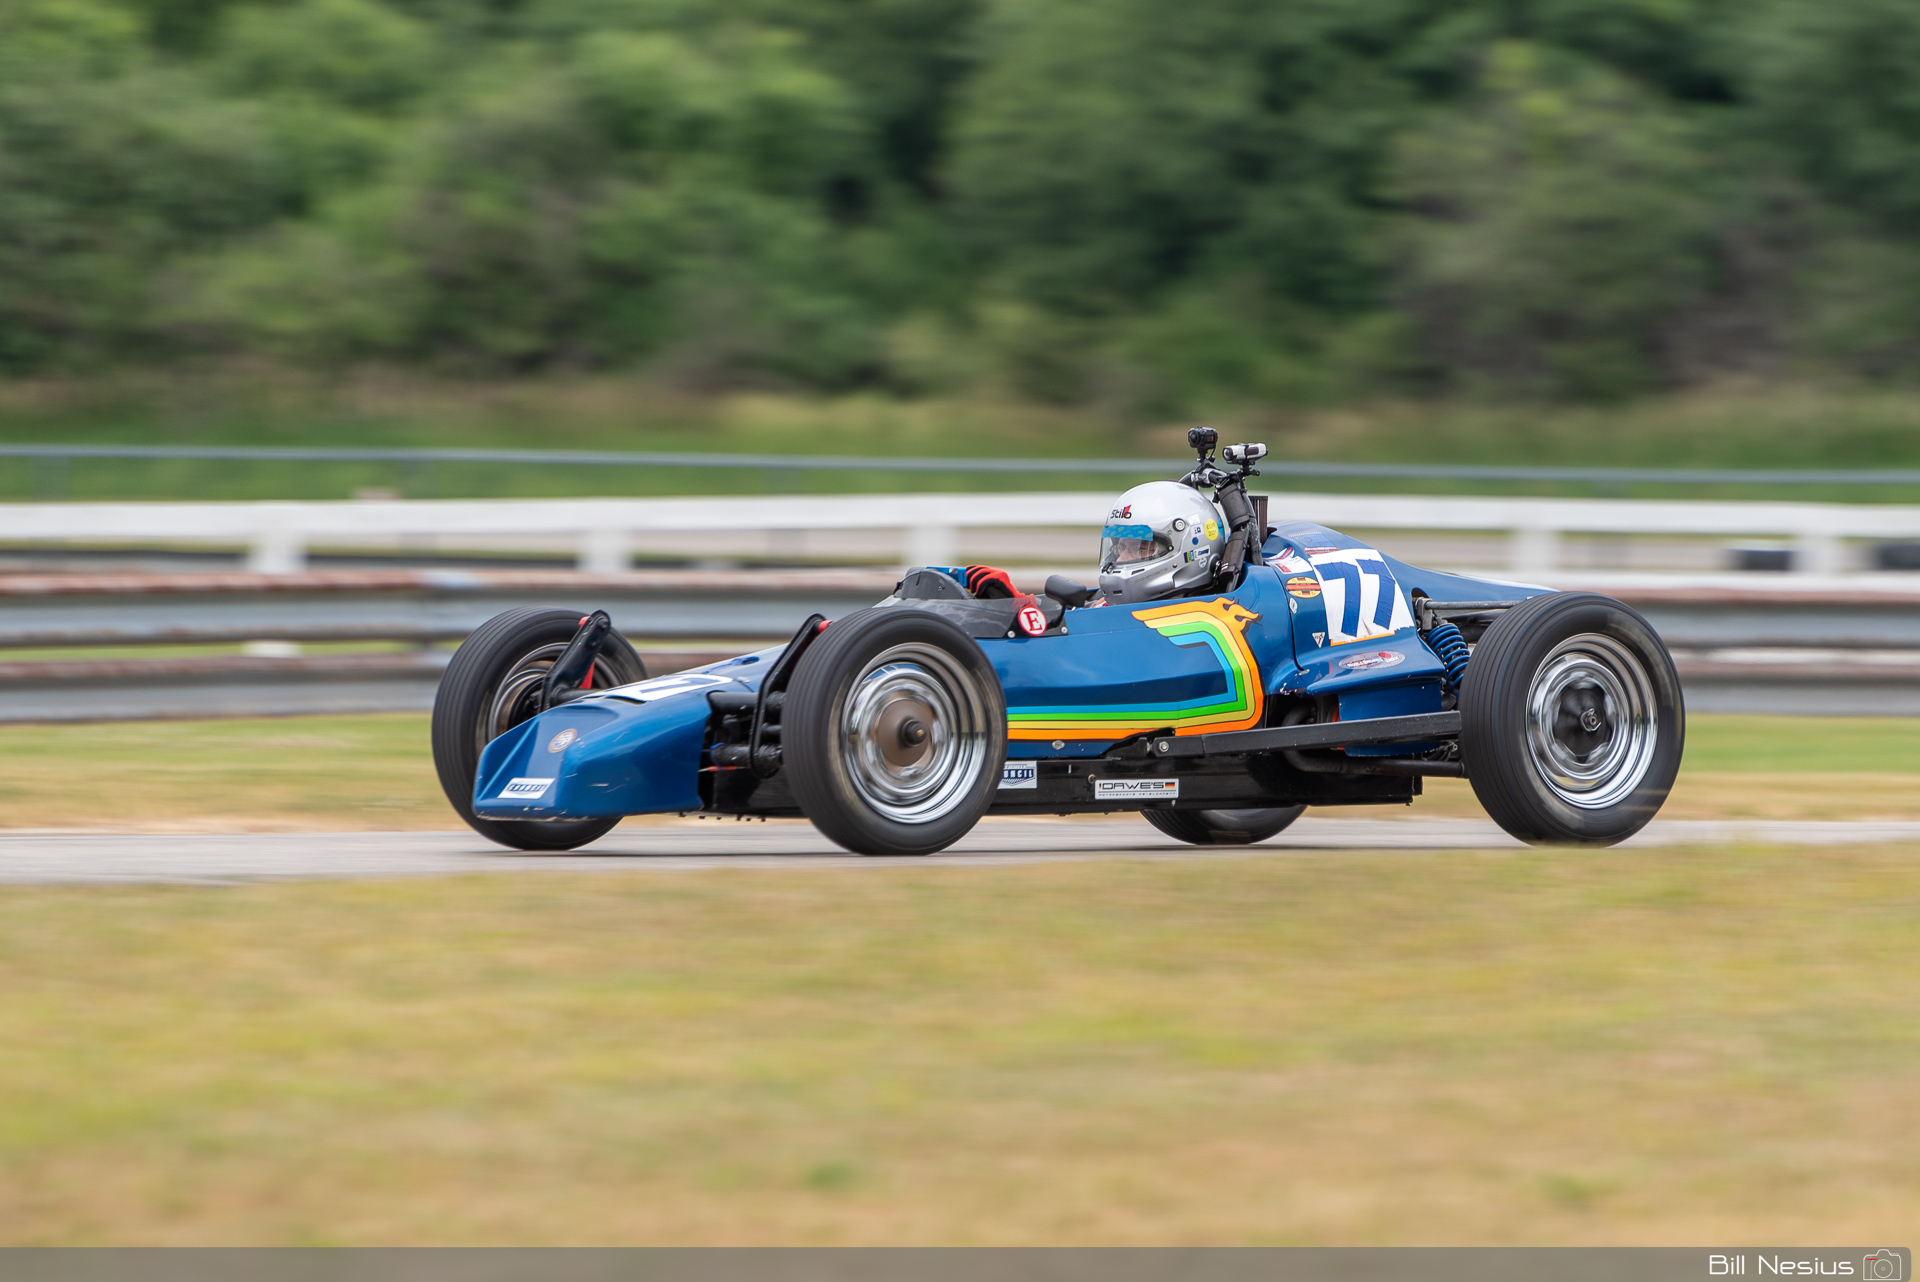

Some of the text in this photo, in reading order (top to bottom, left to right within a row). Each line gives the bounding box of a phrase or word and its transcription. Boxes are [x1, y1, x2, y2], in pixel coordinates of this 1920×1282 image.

[1110, 504, 1132, 519] Stilo
[1313, 558, 1396, 638] 77
[1023, 610, 1043, 632] E
[1003, 769, 1034, 779] UNCIL
